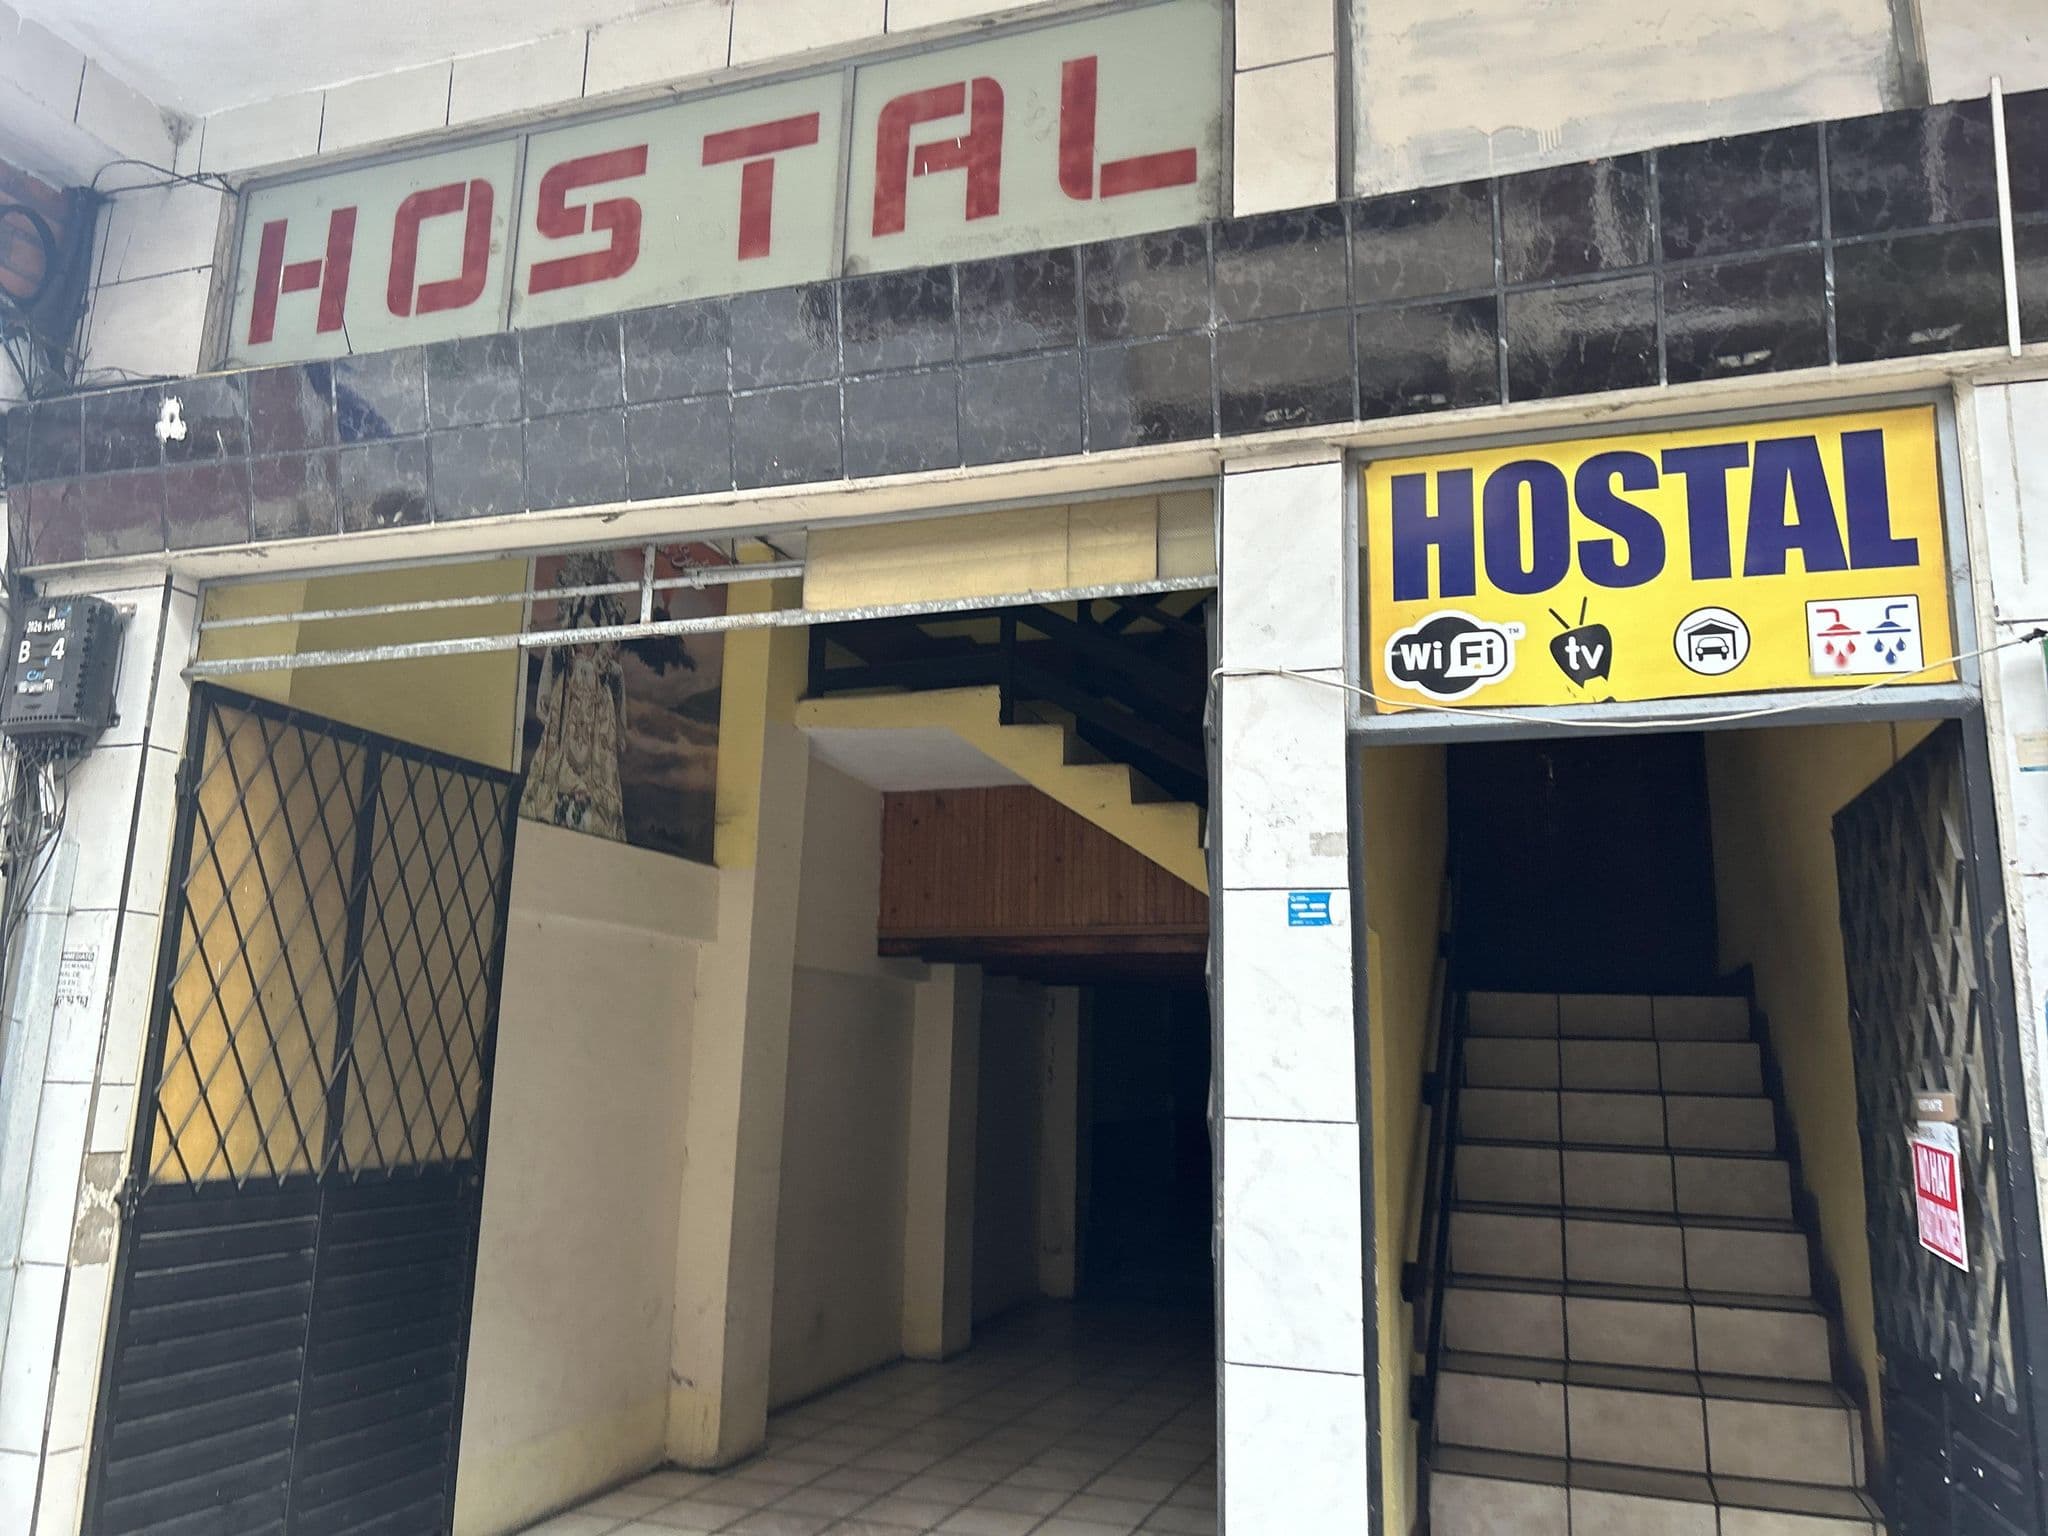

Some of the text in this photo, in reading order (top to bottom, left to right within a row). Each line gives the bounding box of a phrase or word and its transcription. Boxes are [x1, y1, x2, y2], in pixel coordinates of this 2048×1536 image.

[248, 55, 1197, 345] HOSTAL
[1391, 429, 1919, 602] HOSTAL
[18, 637, 65, 663] B 4
[1564, 636, 1604, 671] tv
